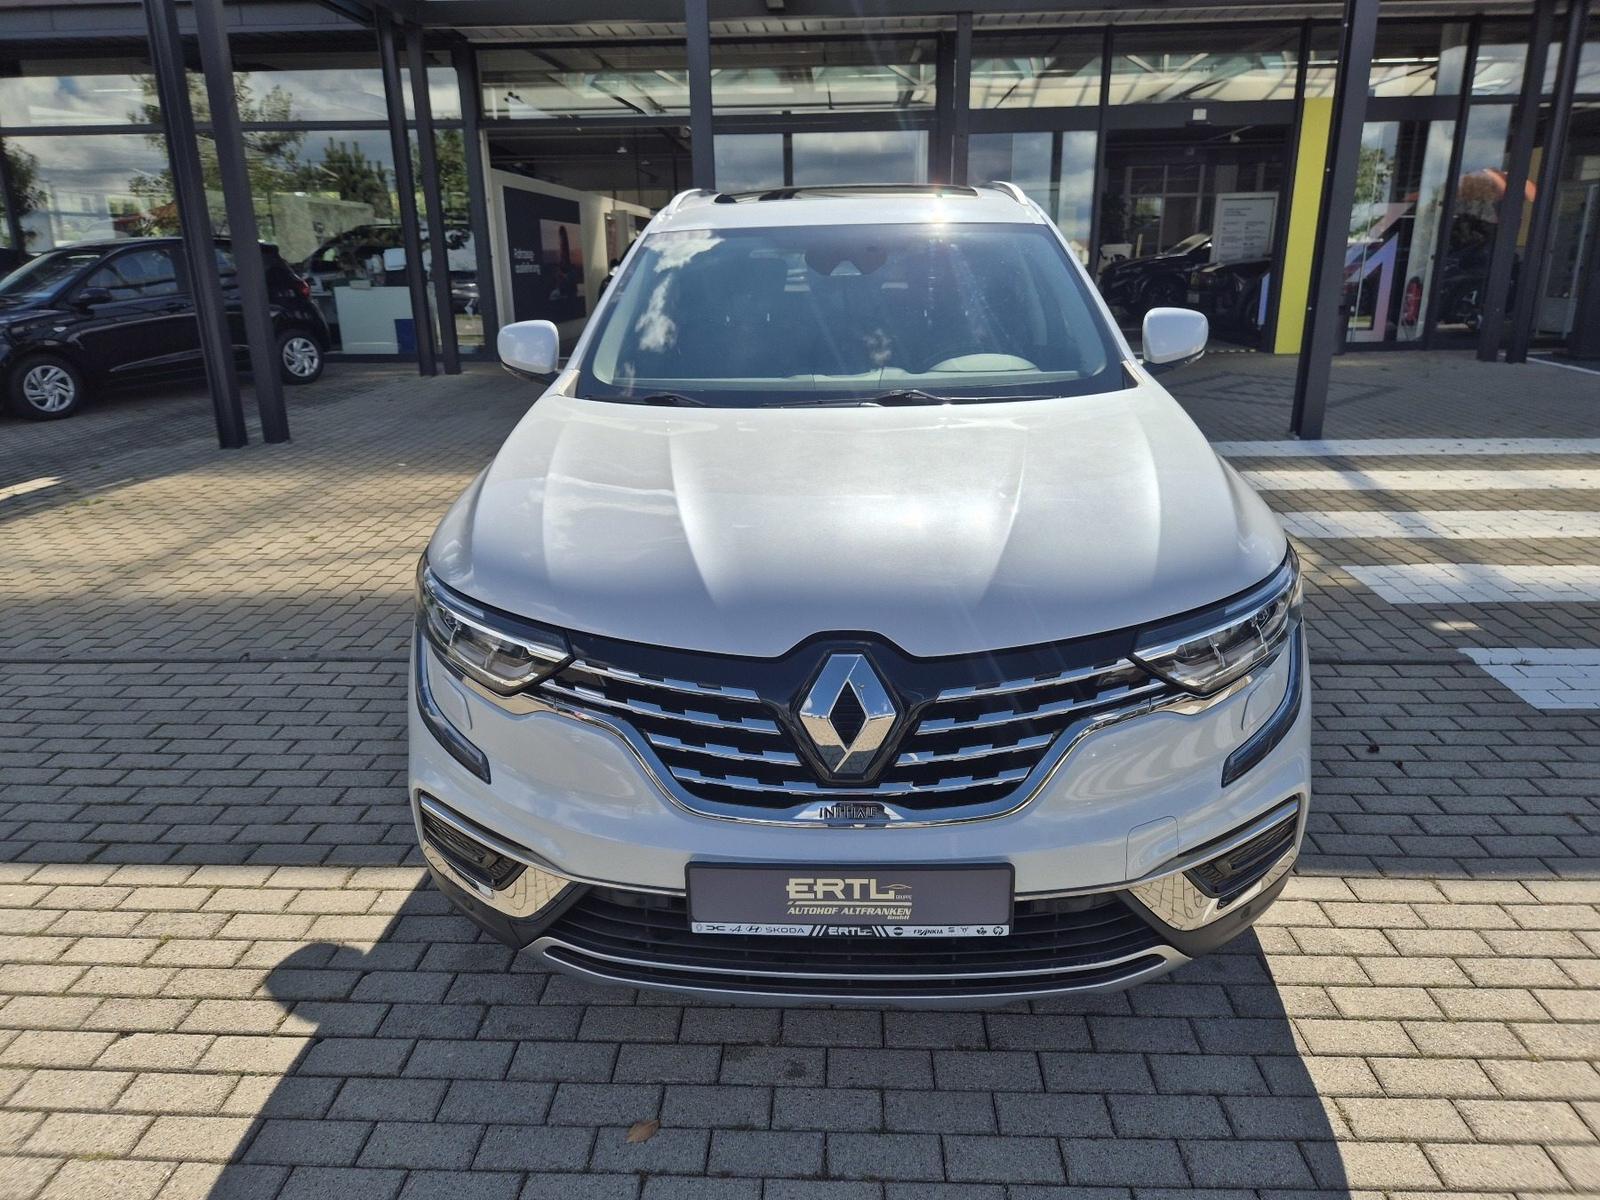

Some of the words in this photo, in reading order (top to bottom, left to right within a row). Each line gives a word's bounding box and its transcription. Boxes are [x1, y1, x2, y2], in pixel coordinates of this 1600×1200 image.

[786, 878, 895, 900] ERTL
[787, 907, 839, 915] AUTOHOF
[841, 907, 912, 916] ALTFRANKEN
[828, 926, 873, 936] ERTL
